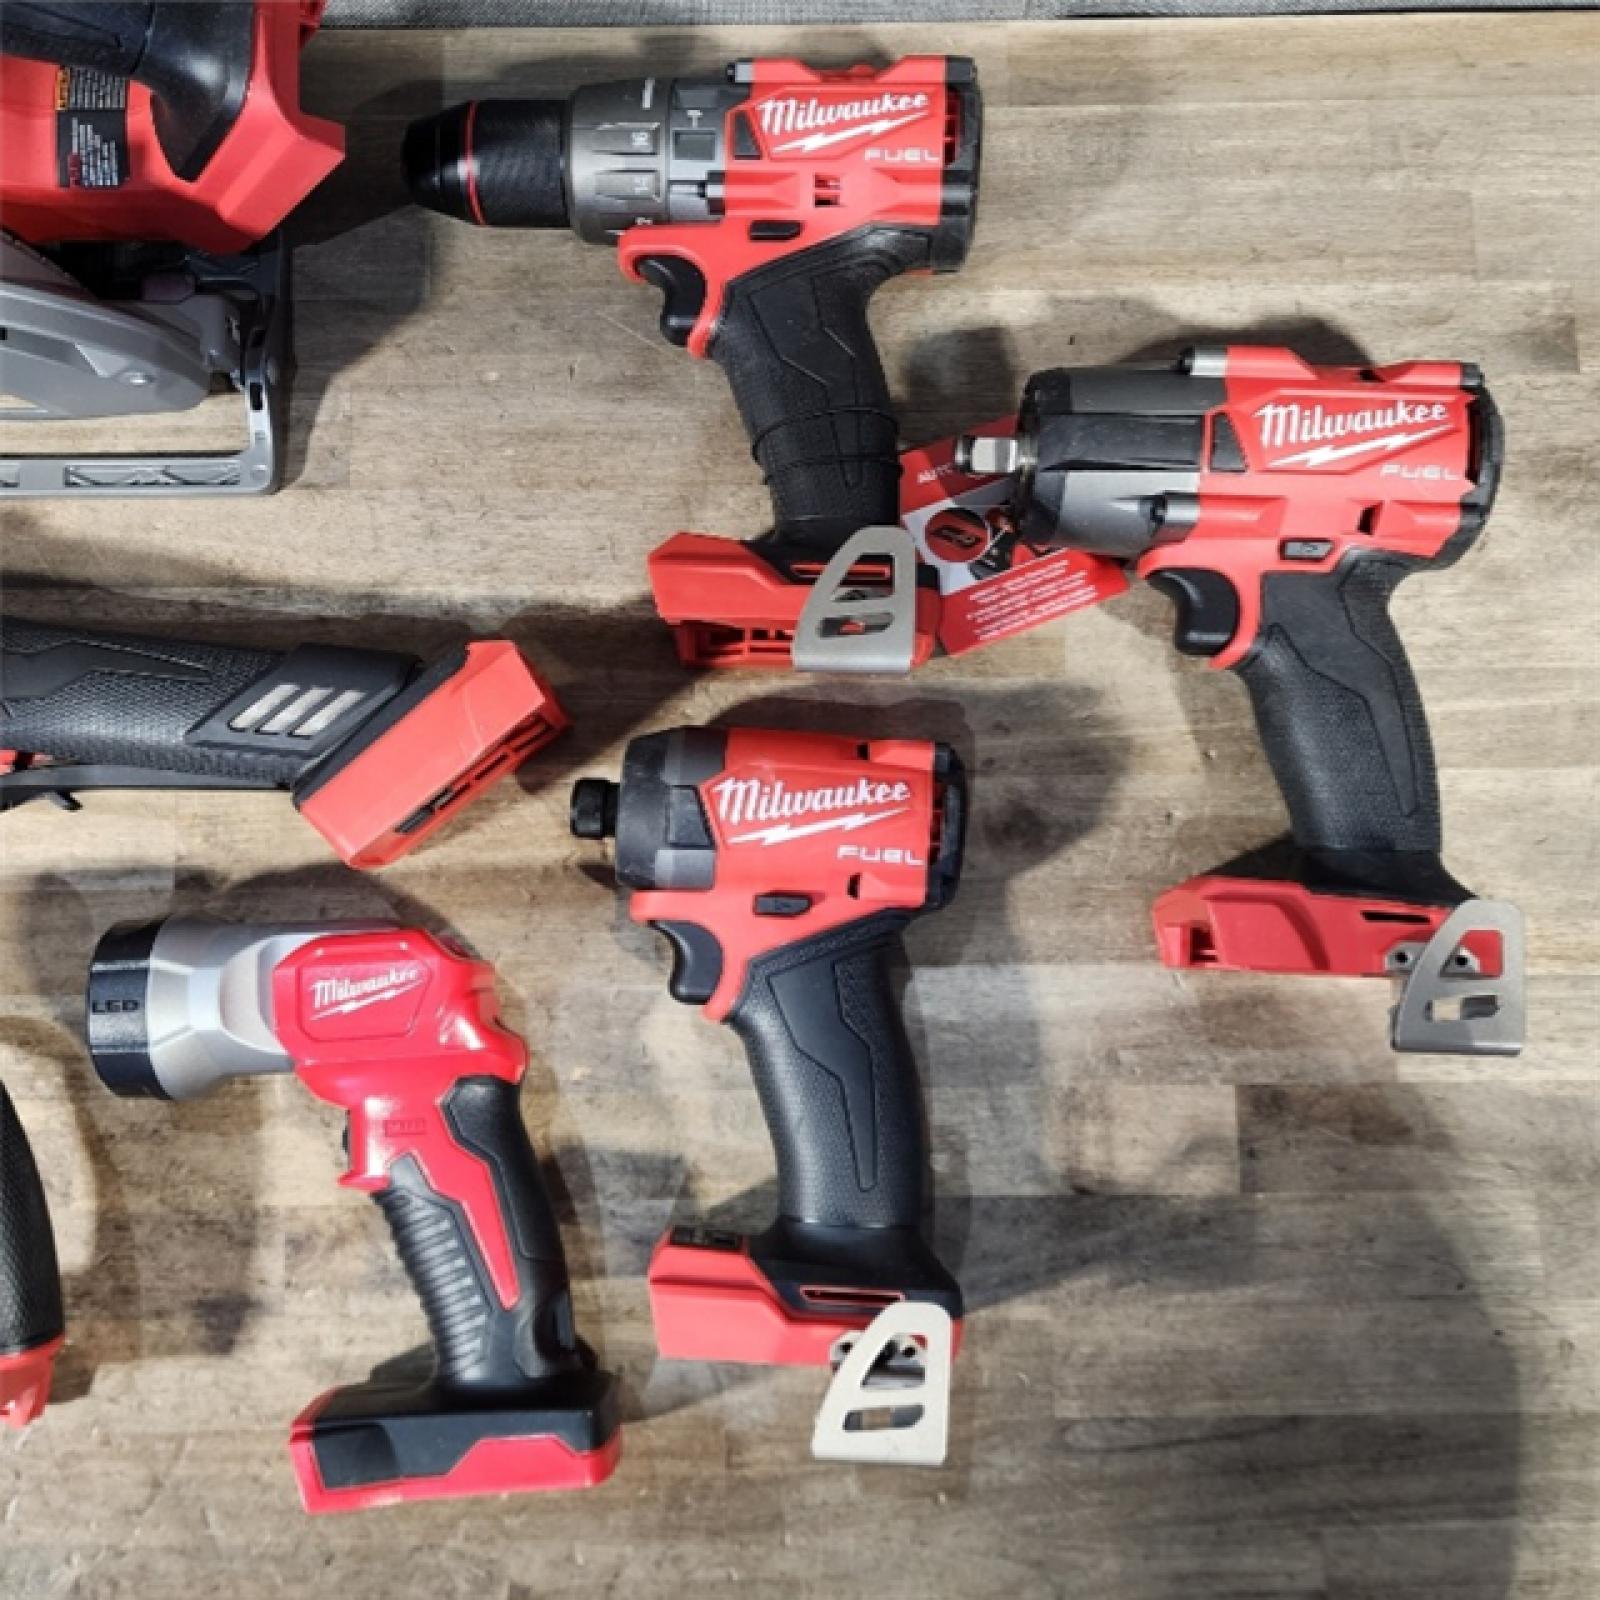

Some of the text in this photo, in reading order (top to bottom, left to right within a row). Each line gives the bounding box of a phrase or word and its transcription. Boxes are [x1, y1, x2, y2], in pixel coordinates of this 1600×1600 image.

[757, 91, 929, 136] Milwaukee
[864, 147, 940, 162] FUEL
[1253, 400, 1449, 449] Milwaukee
[1379, 462, 1462, 481] FUEL
[711, 776, 911, 825] Milwaukee
[836, 844, 924, 866] FUEL
[309, 966, 419, 1009] Milwaukee
[91, 999, 139, 1014] LED
